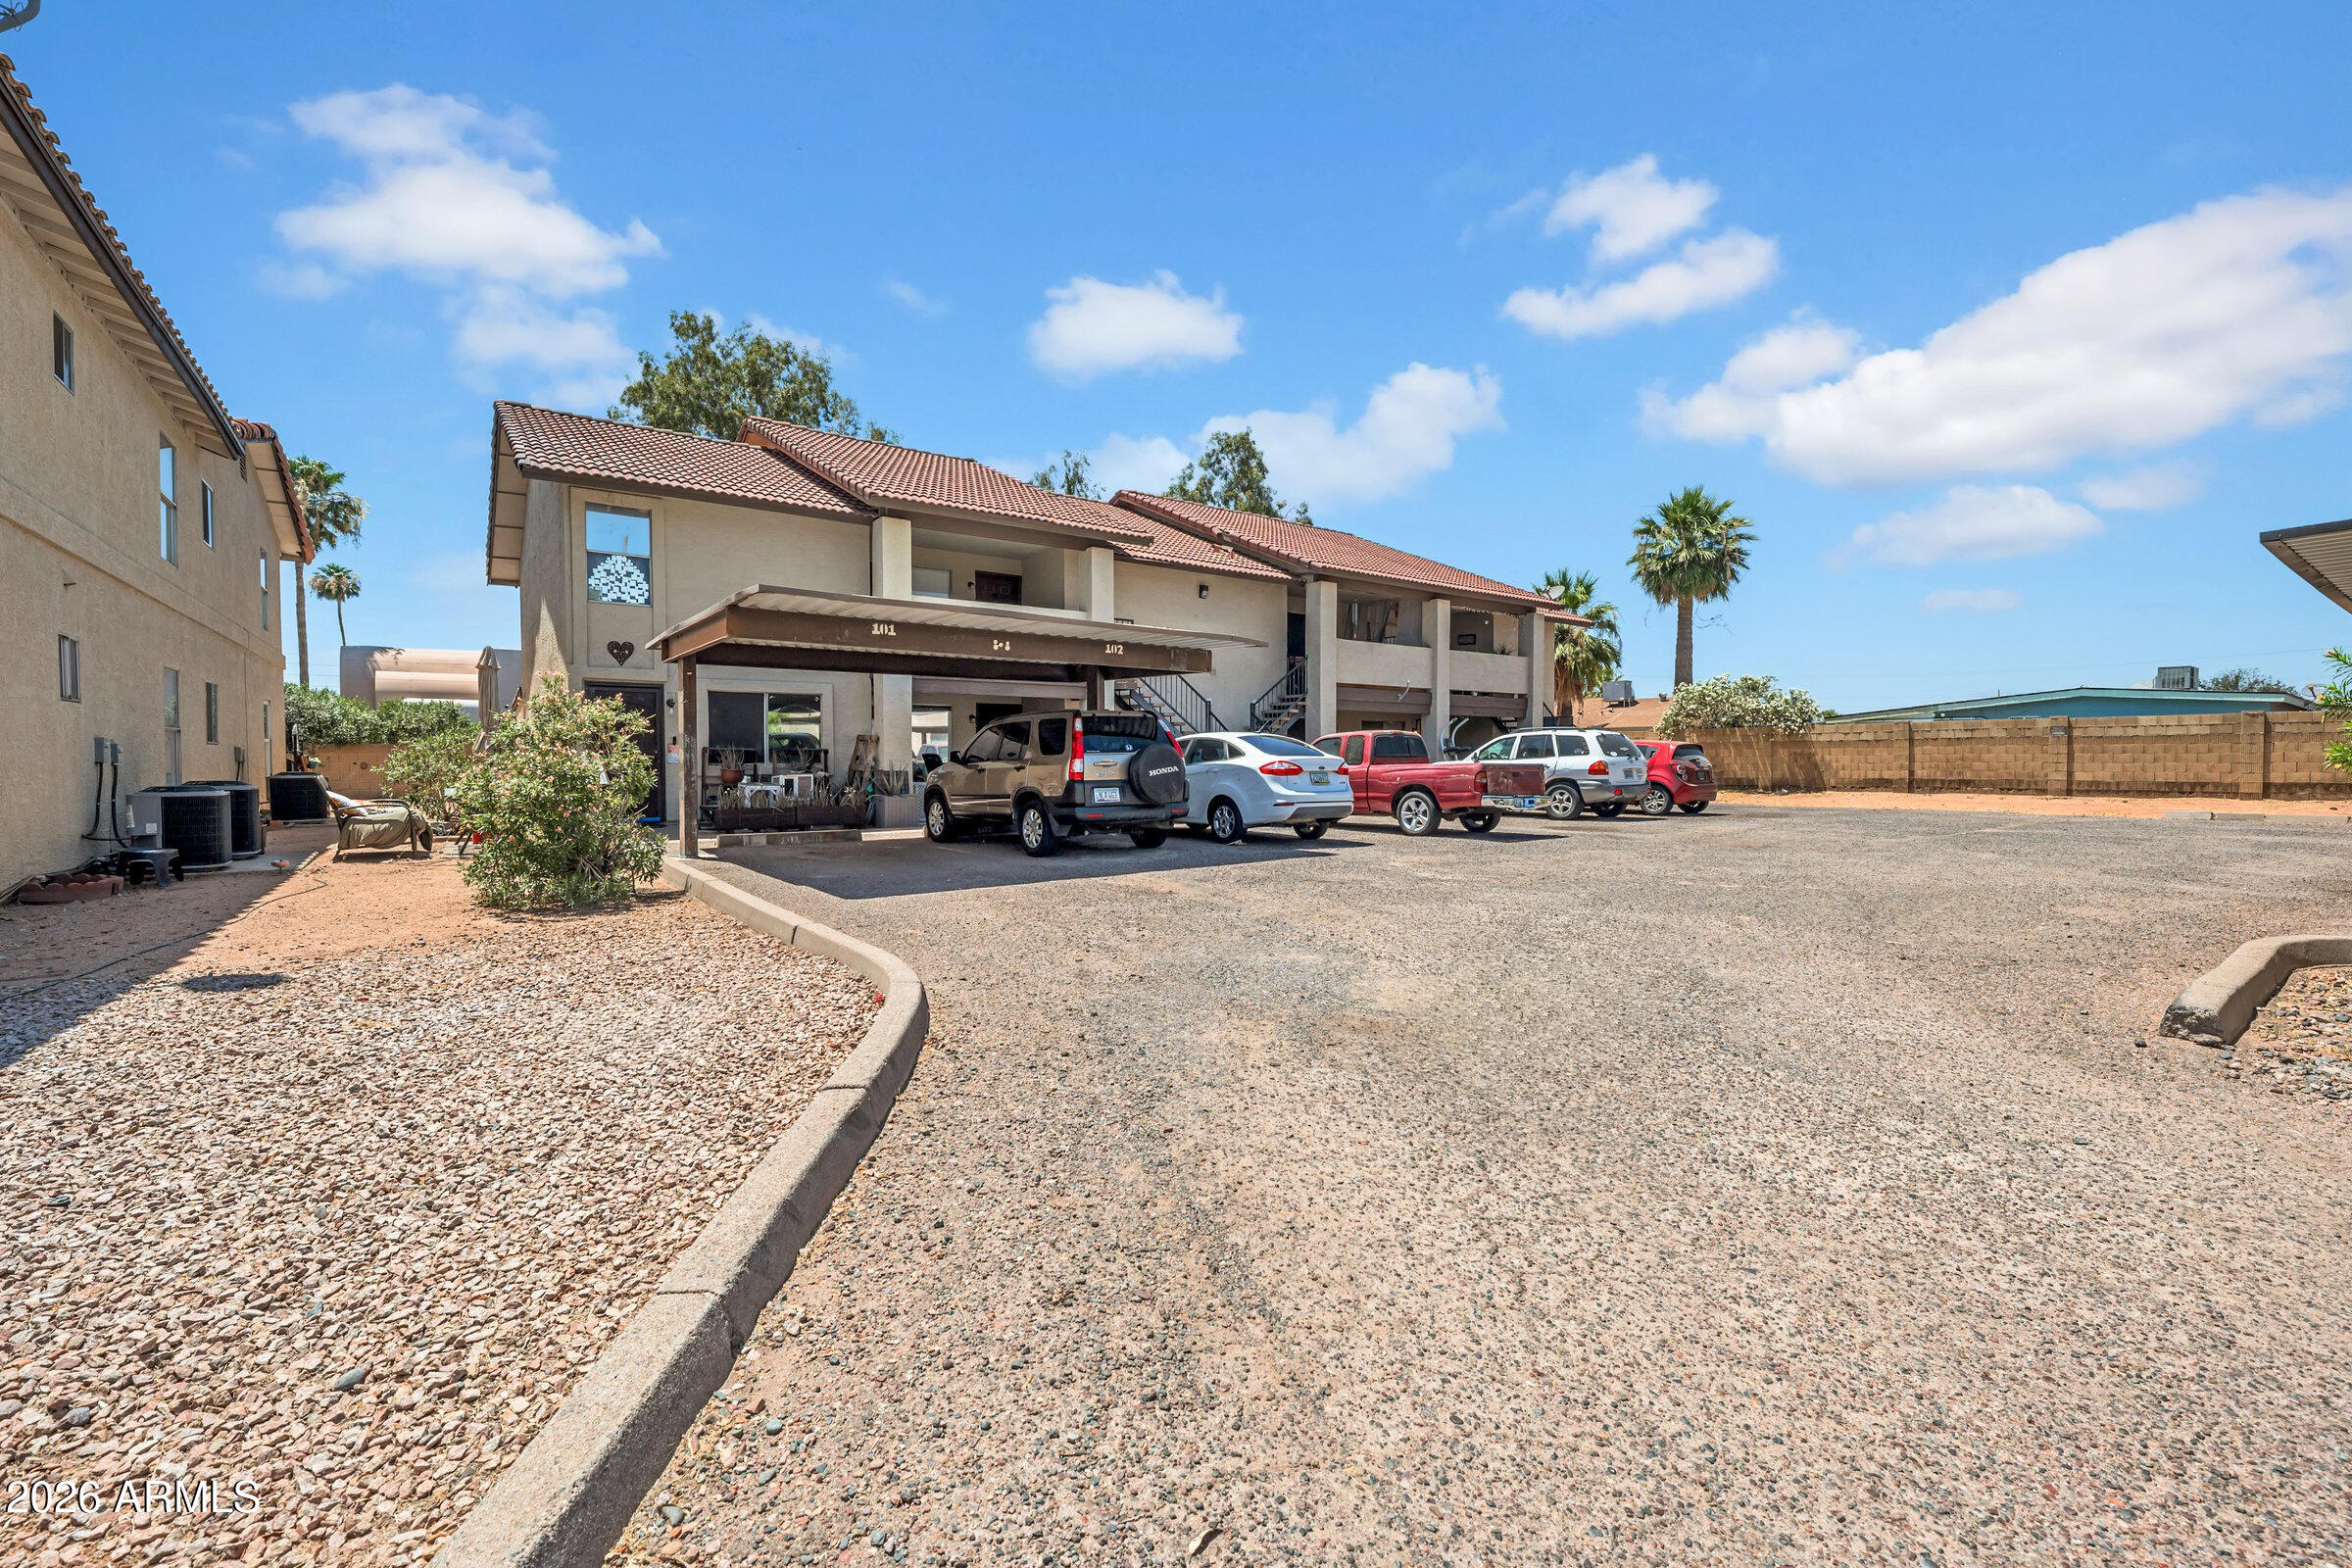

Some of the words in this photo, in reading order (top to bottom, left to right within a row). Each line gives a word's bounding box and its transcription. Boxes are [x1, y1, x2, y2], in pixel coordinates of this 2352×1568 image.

[871, 622, 897, 636] 101
[1104, 643, 1124, 656] 102
[1149, 765, 1180, 777] HONDA
